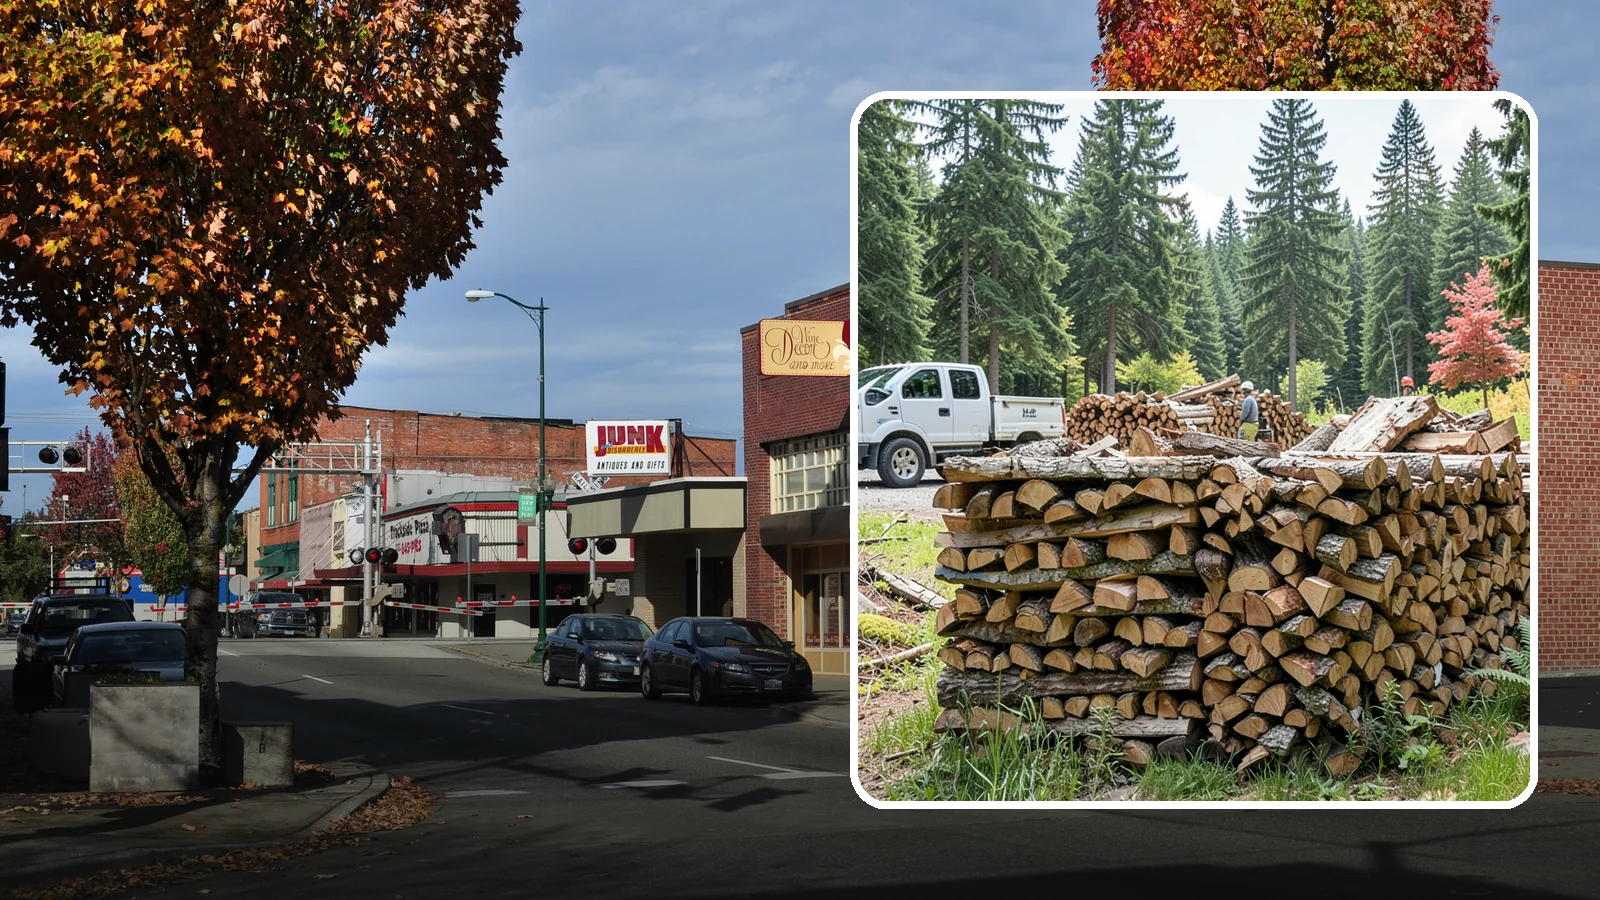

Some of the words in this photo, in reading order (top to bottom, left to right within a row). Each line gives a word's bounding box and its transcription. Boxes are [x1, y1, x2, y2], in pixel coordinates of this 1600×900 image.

[596, 426, 665, 457] JUNK
[607, 446, 646, 454] DISORDERLY
[597, 461, 628, 470] ANTIQUES
[631, 461, 644, 470] AND
[646, 460, 665, 470] GIFTS
